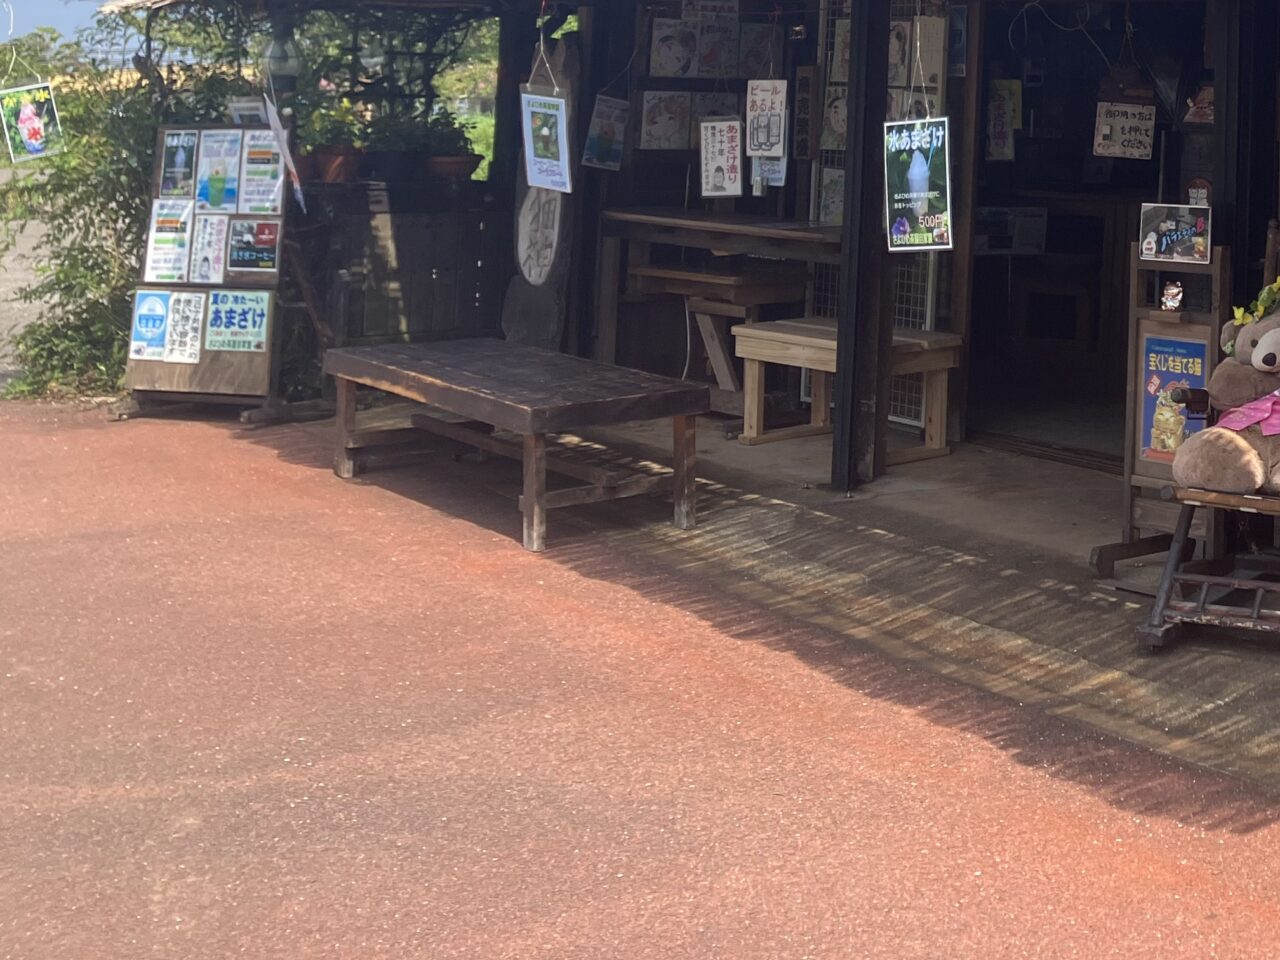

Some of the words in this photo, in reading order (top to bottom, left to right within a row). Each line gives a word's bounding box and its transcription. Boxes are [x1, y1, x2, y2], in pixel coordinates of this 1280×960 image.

[751, 85, 781, 96] ビール
[1104, 109, 1153, 121] 御用の方は
[1120, 125, 1151, 138] を押して
[1121, 138, 1152, 150] ください
[726, 123, 739, 185] あまざけ造り
[918, 214, 944, 228] 500円
[209, 306, 266, 329] あまざけ
